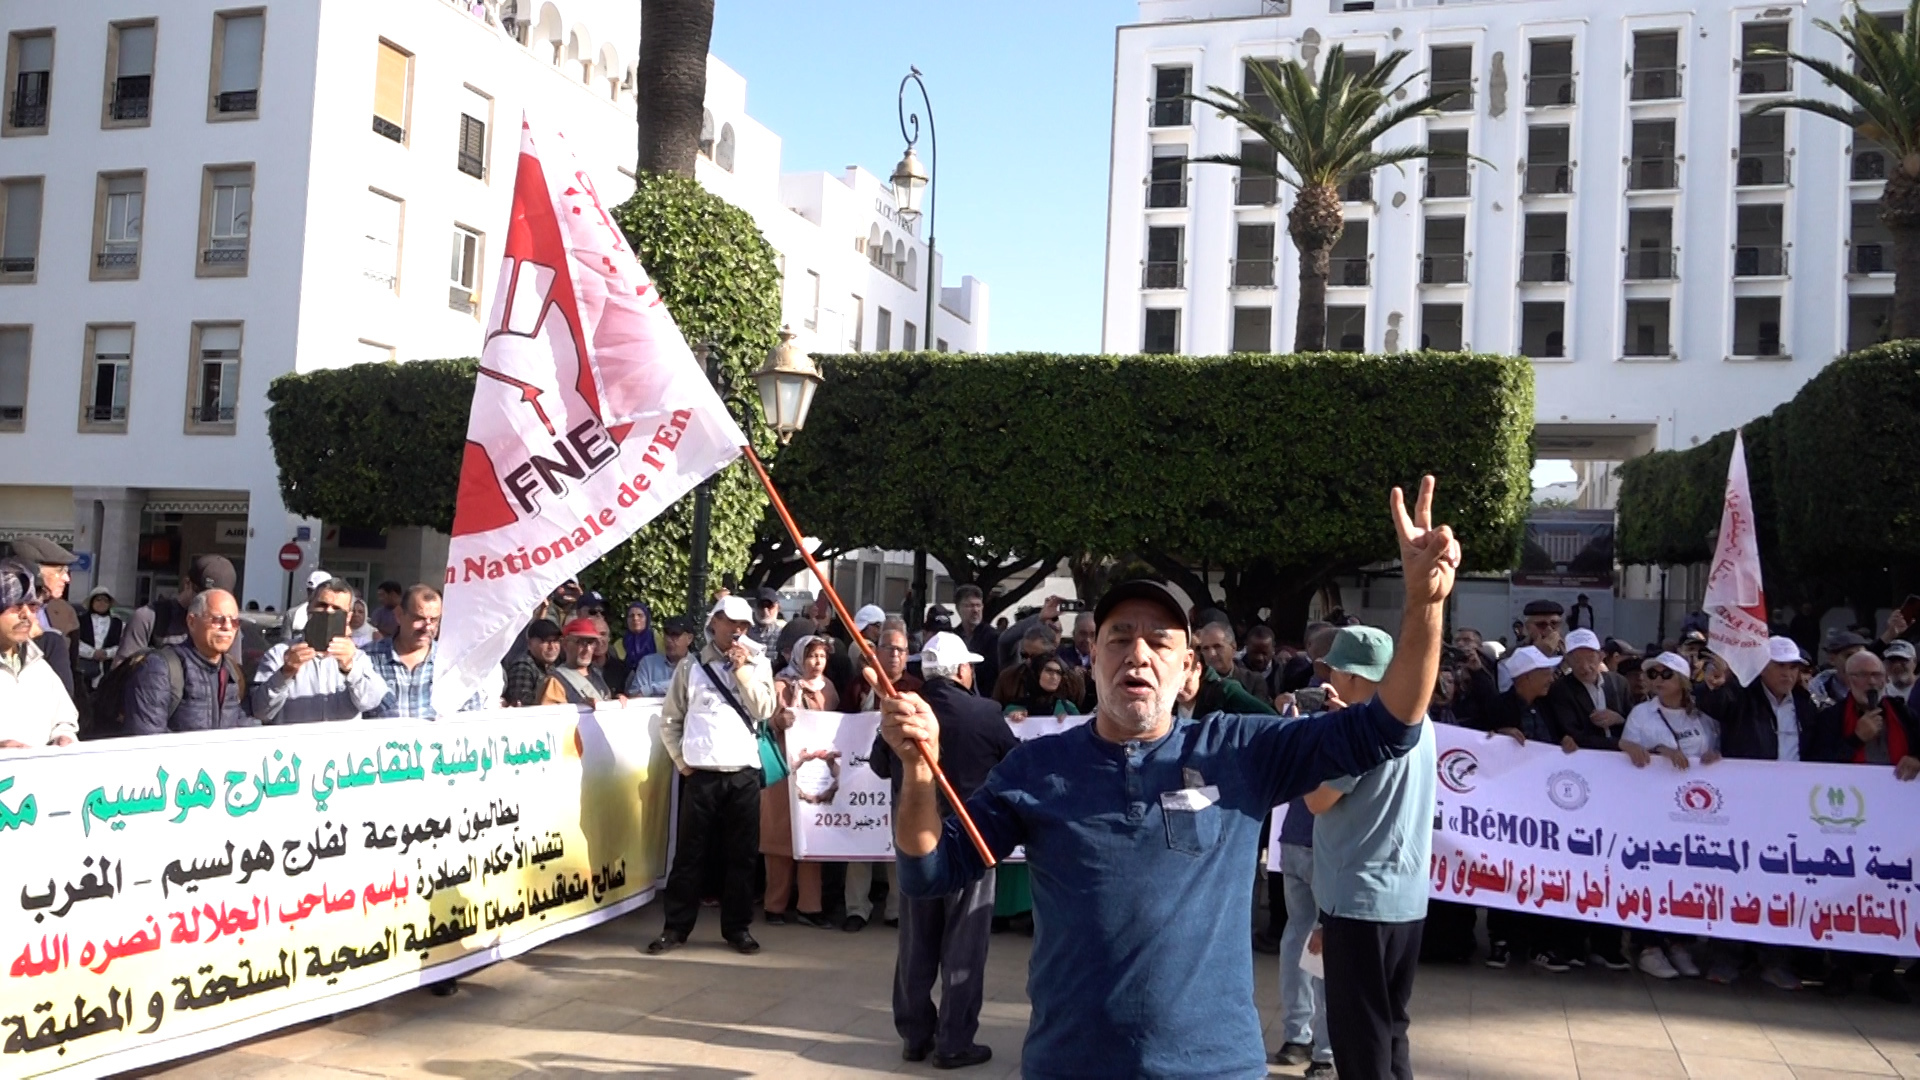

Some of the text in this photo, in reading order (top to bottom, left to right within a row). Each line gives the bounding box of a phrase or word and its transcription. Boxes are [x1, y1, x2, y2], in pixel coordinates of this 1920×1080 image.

[504, 418, 620, 517] FNE
[463, 506, 617, 582] Nationale
[617, 473, 651, 508] de
[312, 738, 426, 812] لمتقاعدي
[430, 736, 498, 786] الوطنية
[500, 732, 557, 775] الجمعية
[82, 764, 216, 838] هولسيم
[224, 749, 302, 818] لفارج
[849, 791, 886, 806] 2012
[361, 816, 452, 856] مجموعة
[458, 798, 520, 843] يطالبون
[814, 813, 851, 827] 2023
[161, 839, 275, 900] هولسيم
[282, 820, 349, 877] لفارج
[482, 827, 529, 886] الأحكام
[530, 830, 564, 871] تنفيذ
[1452, 849, 1514, 897] الحقوق
[1759, 832, 1856, 884] لهيآت
[20, 855, 123, 924] المغرب
[416, 854, 478, 900] الصادرة
[591, 859, 626, 905] لصالح
[1516, 863, 1571, 909] انتزاع
[1575, 864, 1611, 917] أجل
[168, 894, 270, 946] الجلالة
[278, 881, 356, 931] صاحب
[1616, 883, 1652, 923] ومن
[1658, 879, 1724, 930] الإقصاء
[1730, 892, 1761, 924] ضد
[9, 932, 70, 978] الله
[79, 913, 162, 975] نصره
[303, 925, 398, 985] الصحية
[403, 905, 479, 959] للتغطية
[171, 947, 298, 1011] المستحقة
[0, 985, 133, 1056] المطبقة
[138, 991, 165, 1034] و
